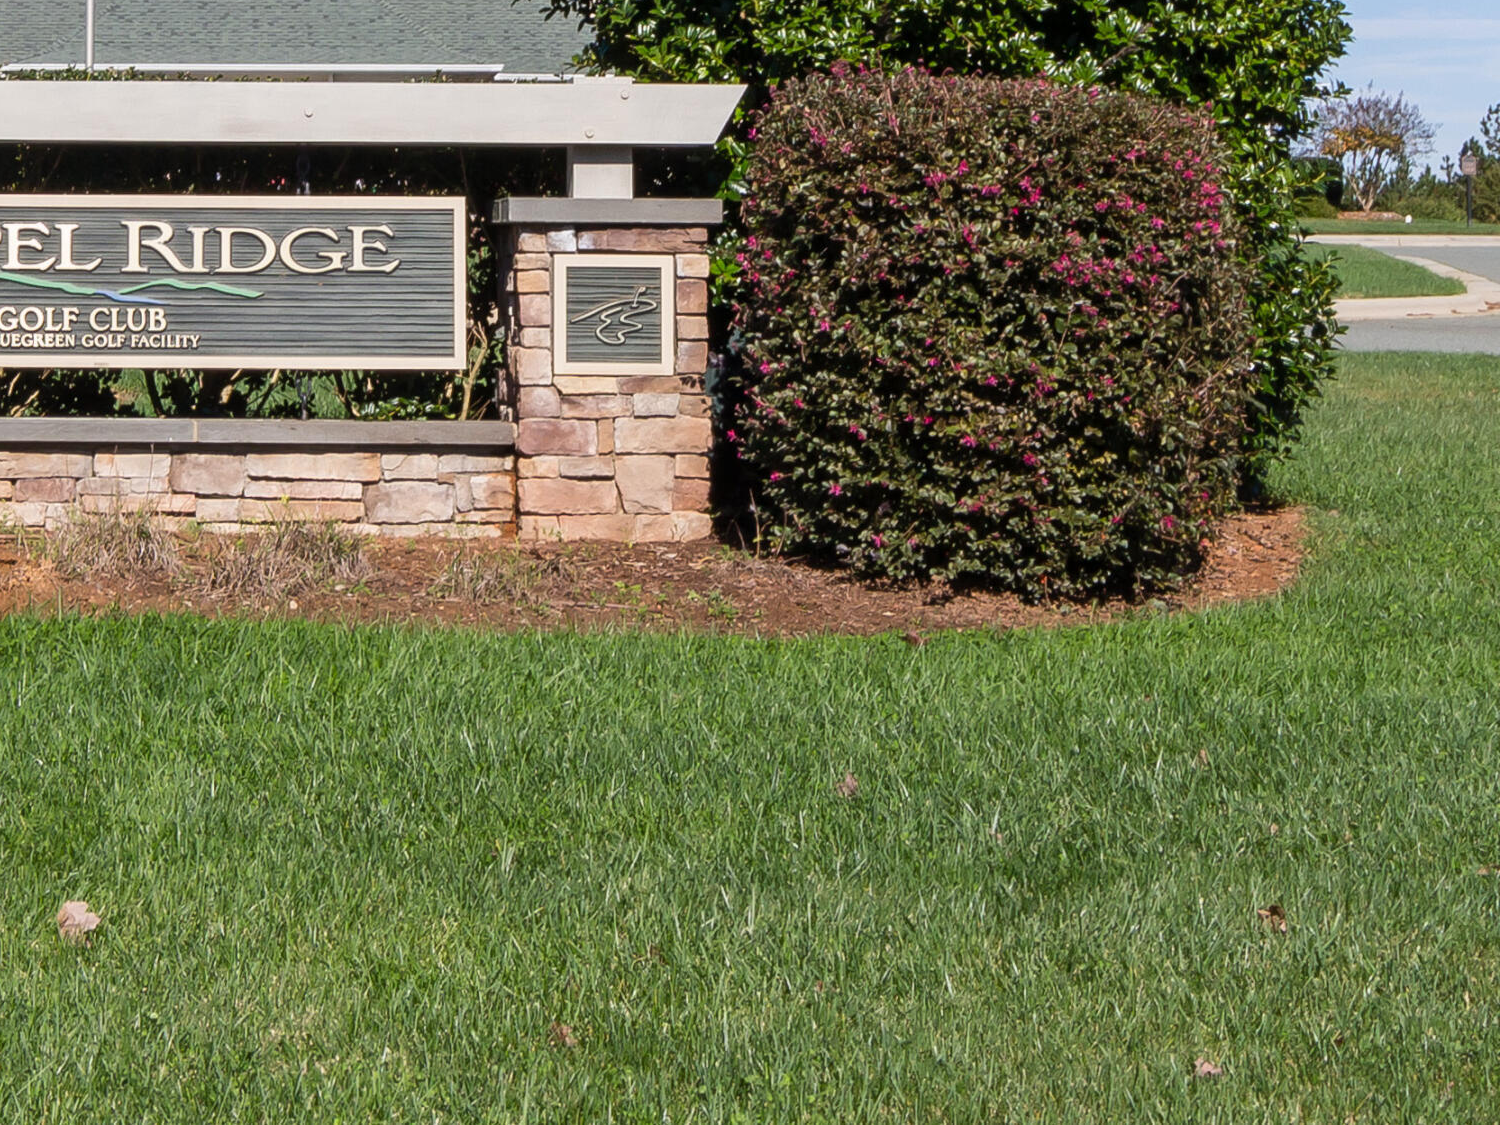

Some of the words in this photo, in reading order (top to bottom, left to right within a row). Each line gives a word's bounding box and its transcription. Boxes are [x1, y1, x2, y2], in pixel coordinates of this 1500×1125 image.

[120, 218, 401, 274] RIDGE
[88, 306, 168, 332] CLUB
[81, 332, 127, 349] GOLF
[130, 333, 201, 349] FACILITY
